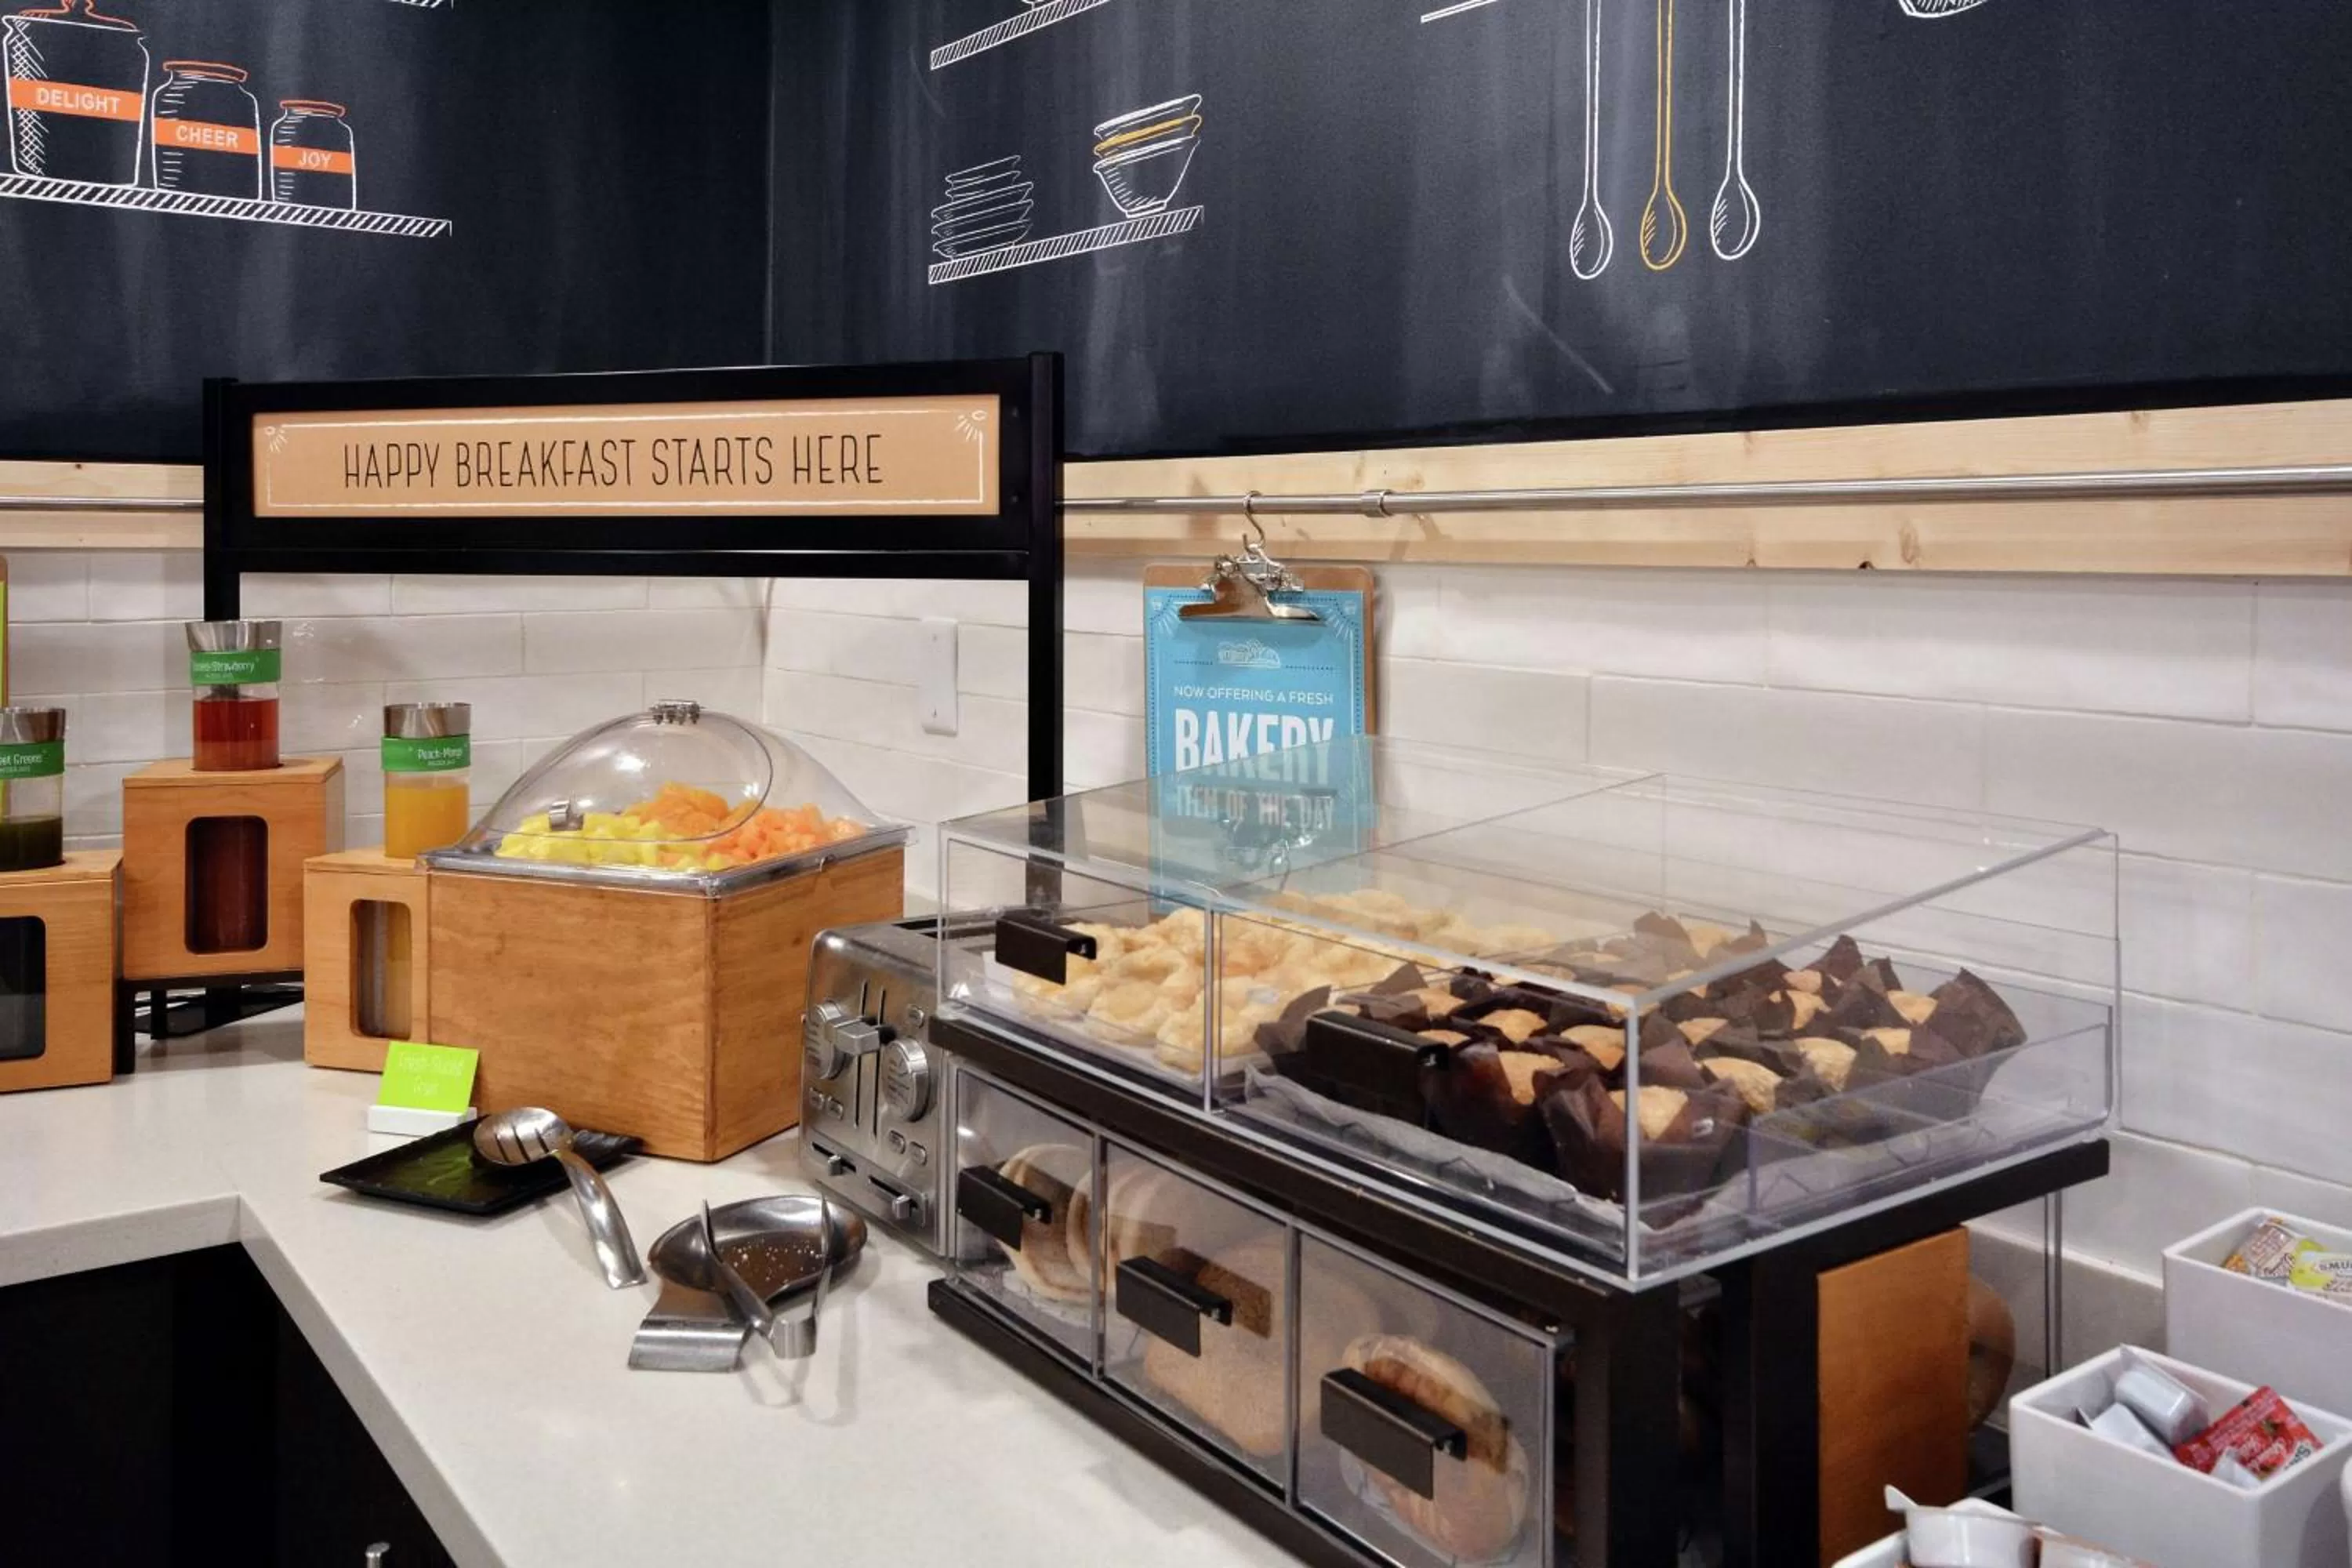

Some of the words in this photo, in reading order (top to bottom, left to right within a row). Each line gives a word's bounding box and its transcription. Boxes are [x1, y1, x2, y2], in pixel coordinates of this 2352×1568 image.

[36, 87, 121, 114] DELIGHT
[175, 125, 239, 147] CHEER
[297, 150, 332, 169] JOY
[343, 442, 440, 488] HAPPY
[456, 439, 636, 488] BREAKFAST
[652, 437, 773, 486] STARTS
[793, 434, 883, 485] HERE
[1174, 685, 1204, 698] NOW
[1206, 687, 1275, 703] OFFERING
[1276, 691, 1287, 703] A
[1289, 691, 1334, 706] FRESH
[1175, 708, 1334, 784] BAKERY
